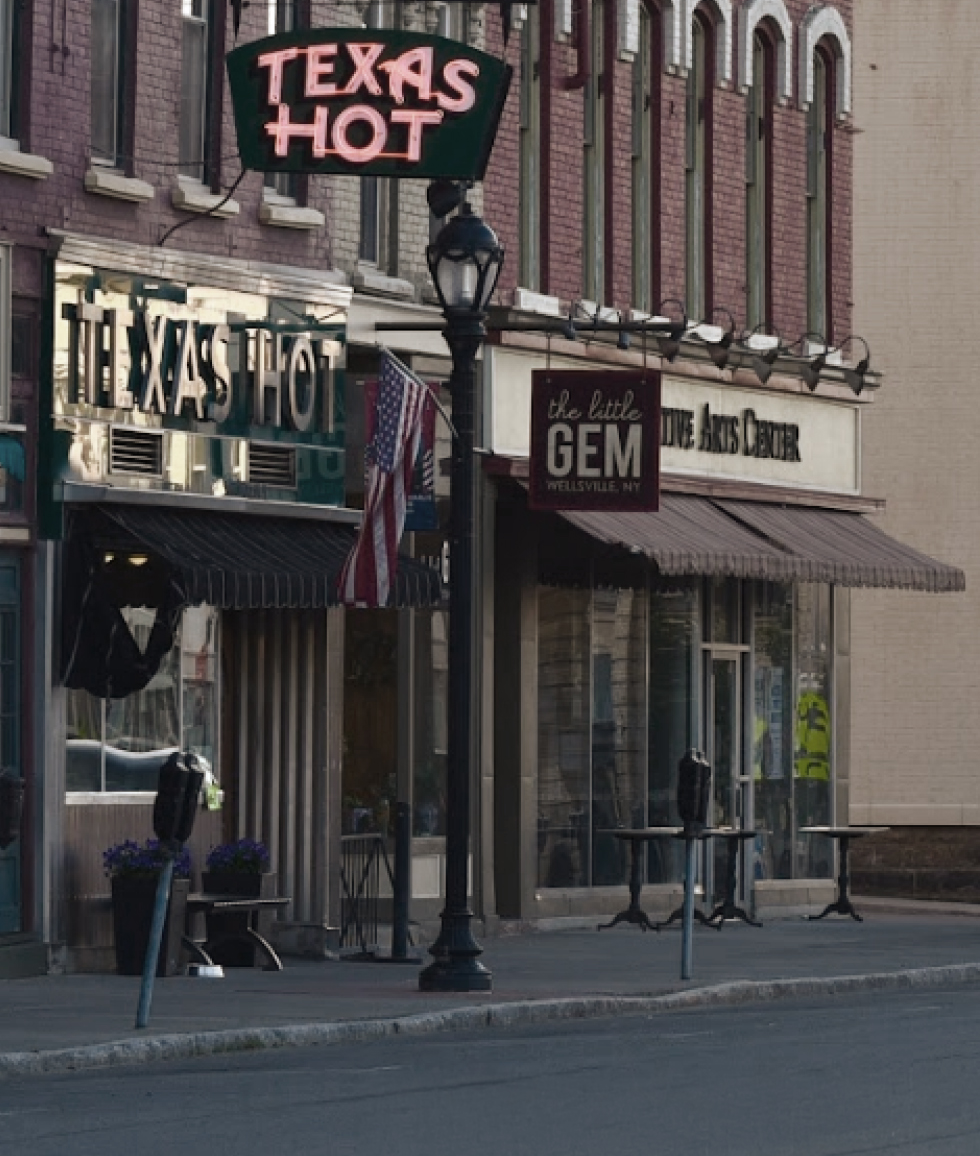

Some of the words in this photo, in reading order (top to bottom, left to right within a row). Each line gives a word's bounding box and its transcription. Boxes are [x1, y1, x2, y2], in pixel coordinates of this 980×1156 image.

[257, 42, 480, 113] TEXAS
[263, 103, 444, 163] HOT
[76, 301, 232, 424] TEXAS
[256, 327, 343, 434] HOT
[547, 390, 582, 420] the
[588, 389, 642, 421] little
[546, 422, 643, 478] GEM
[742, 407, 802, 463] CENTER
[546, 480, 619, 493] WELLSVILLE,
[623, 482, 641, 493] NY
